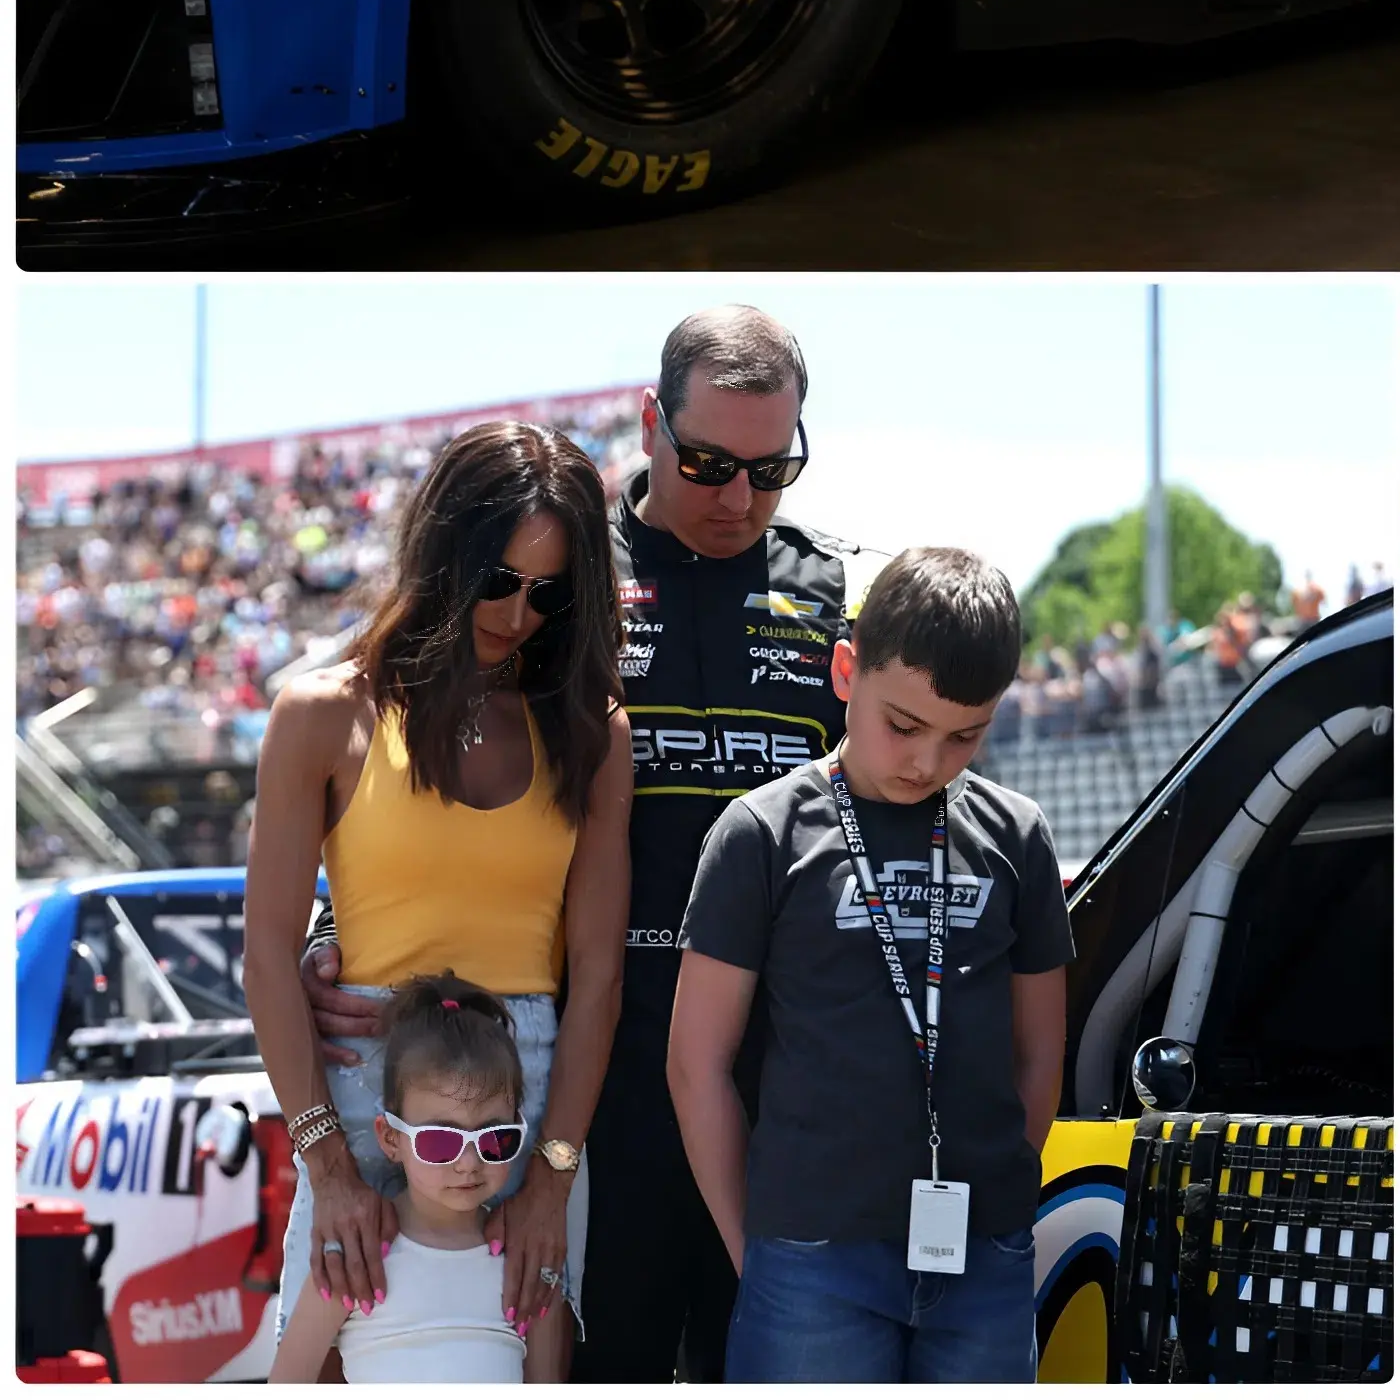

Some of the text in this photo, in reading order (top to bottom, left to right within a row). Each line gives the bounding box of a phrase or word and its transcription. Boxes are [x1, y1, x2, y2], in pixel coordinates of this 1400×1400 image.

[533, 116, 712, 194] EAGLE
[834, 782, 853, 807] CUP
[872, 914, 894, 948] CUP
[928, 937, 944, 966] CUP
[30, 1096, 162, 1194] Mobil
[129, 1287, 243, 1346] SiriusXM
